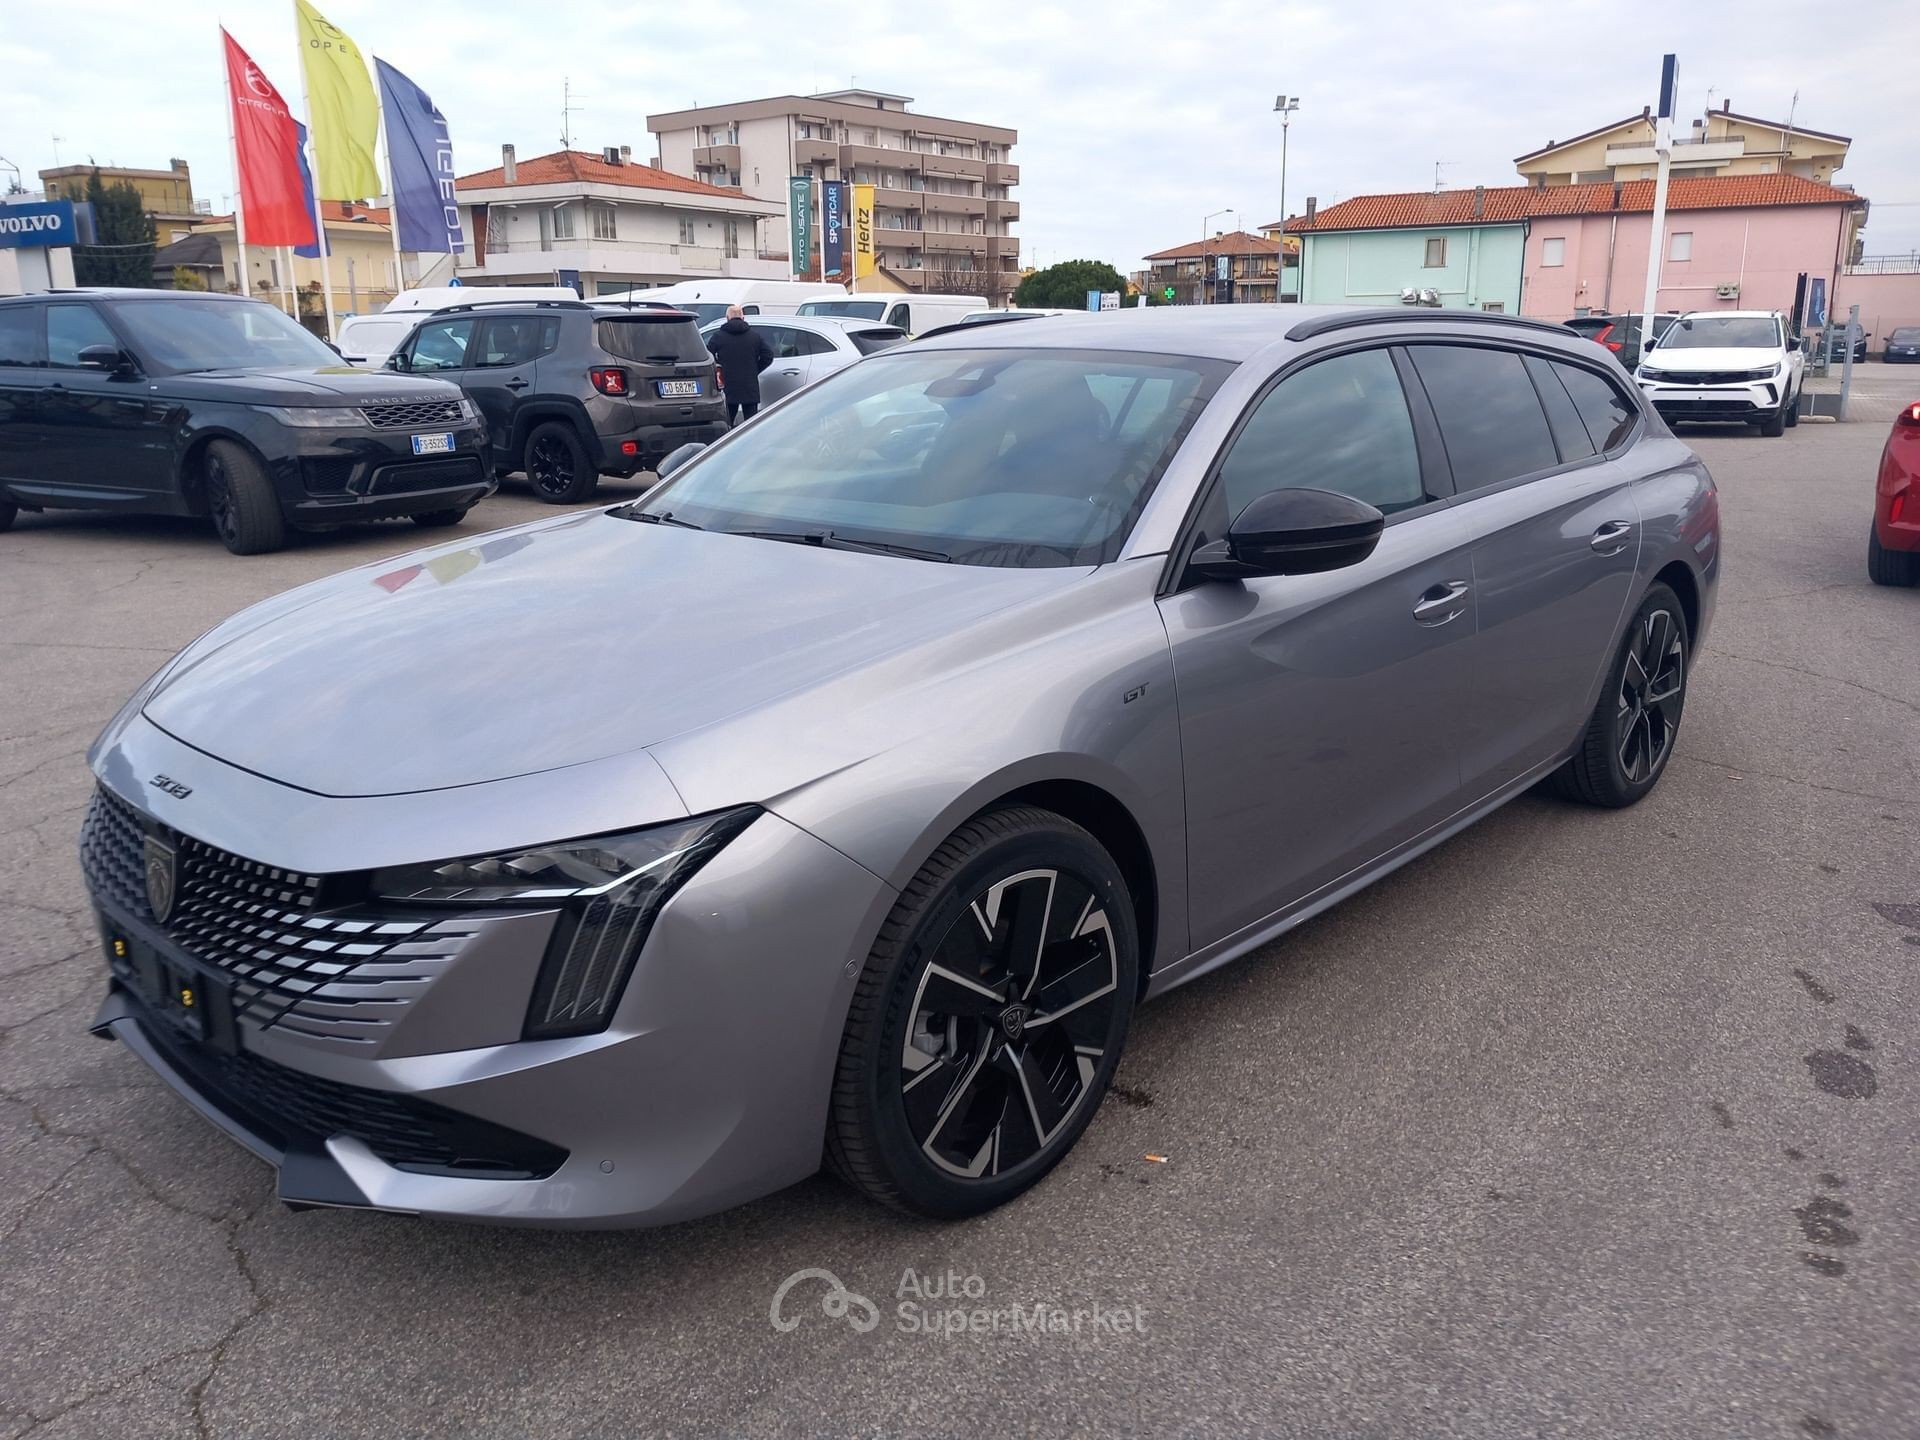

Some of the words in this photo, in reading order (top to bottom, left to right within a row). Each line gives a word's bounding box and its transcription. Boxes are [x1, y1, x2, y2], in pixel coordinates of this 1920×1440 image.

[0, 214, 61, 234] VOLVO
[797, 193, 805, 236] USATE
[858, 207, 870, 254] Hertz
[360, 396, 408, 405] RANGE
[415, 392, 453, 402] ROVER
[1123, 681, 1150, 704] GT
[149, 774, 193, 800] 508
